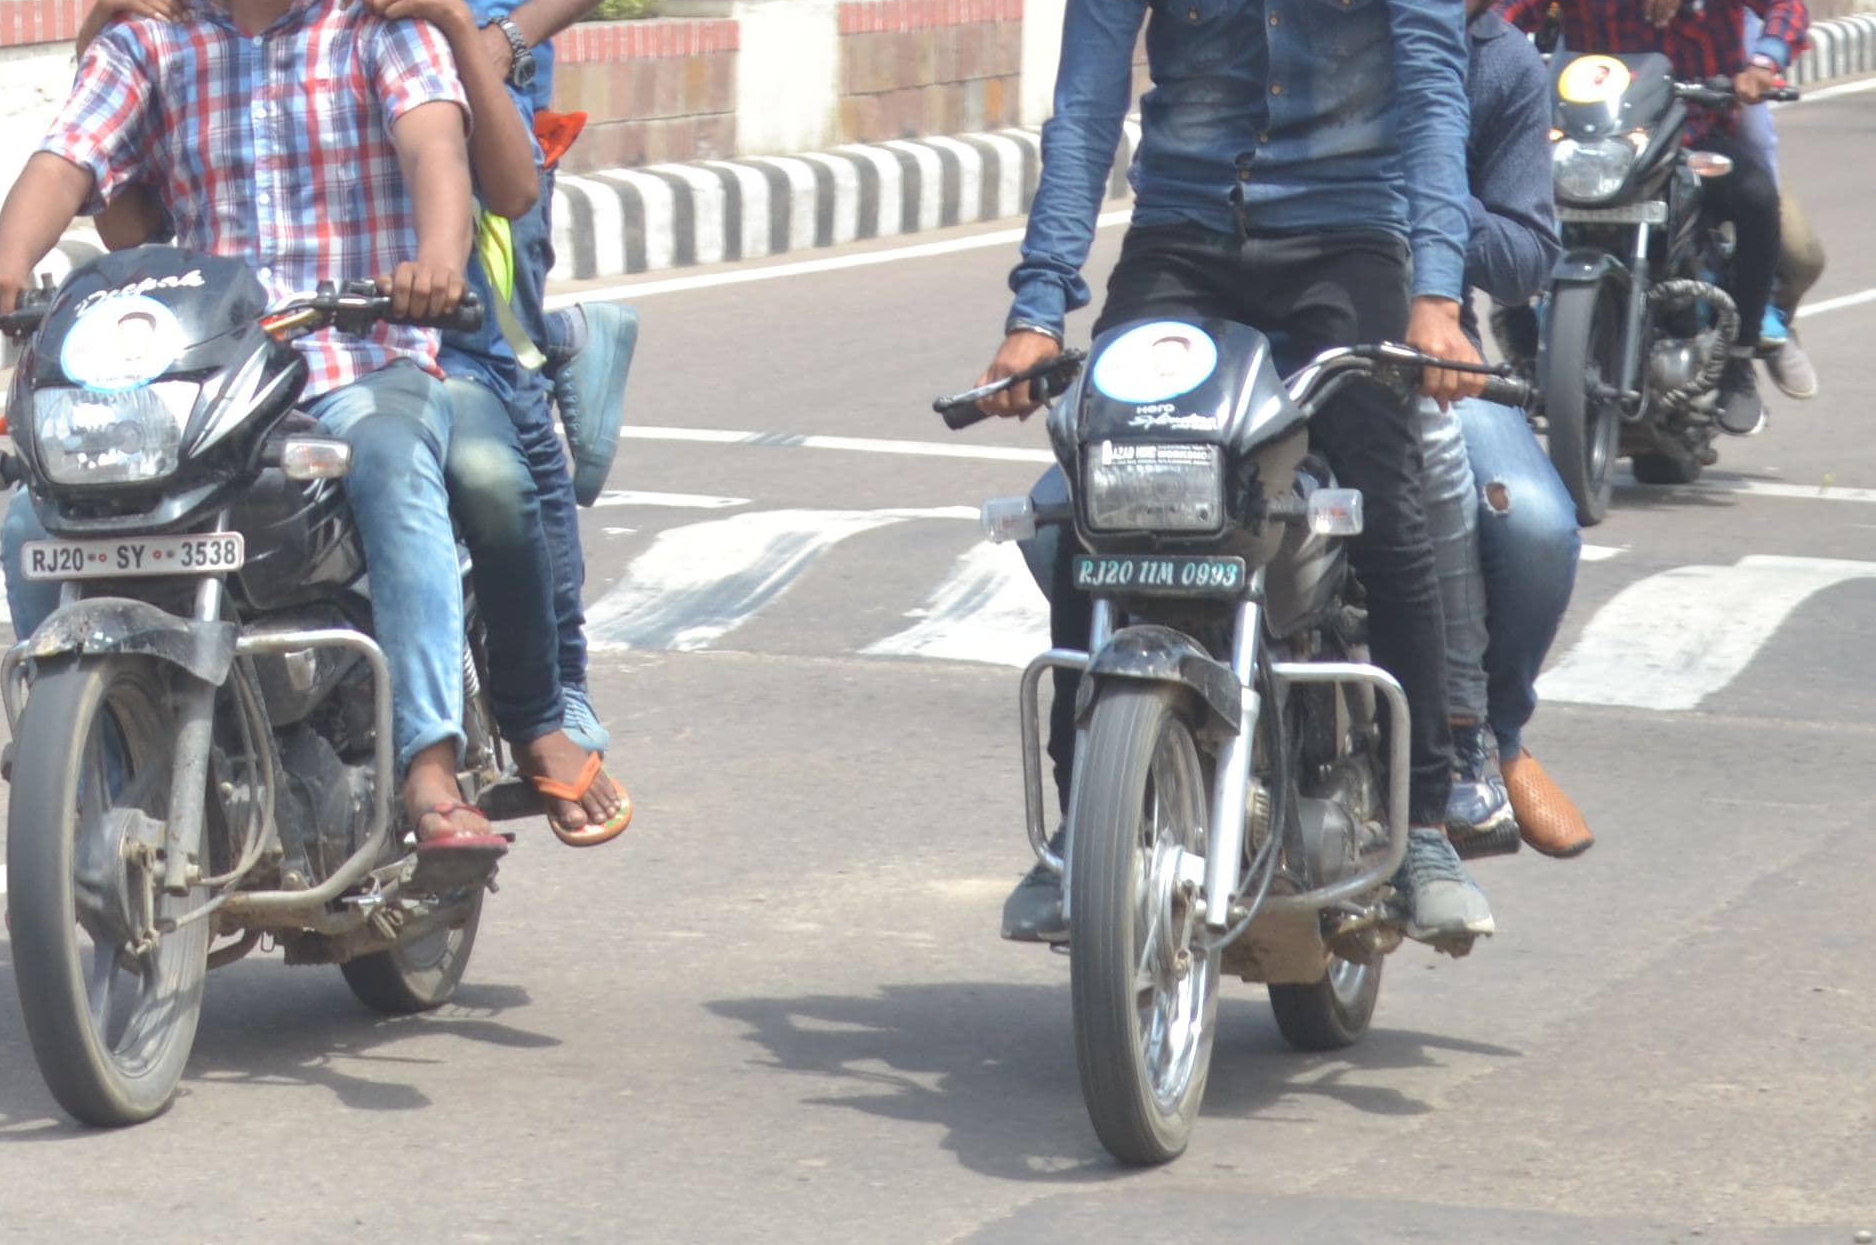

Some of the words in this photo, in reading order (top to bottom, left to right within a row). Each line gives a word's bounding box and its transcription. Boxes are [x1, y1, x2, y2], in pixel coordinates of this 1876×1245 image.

[32, 547, 85, 572] RJ20
[116, 544, 145, 569] SY
[180, 540, 237, 567] 3538
[1078, 559, 1134, 585] RJ20
[1180, 562, 1239, 586] 0993
